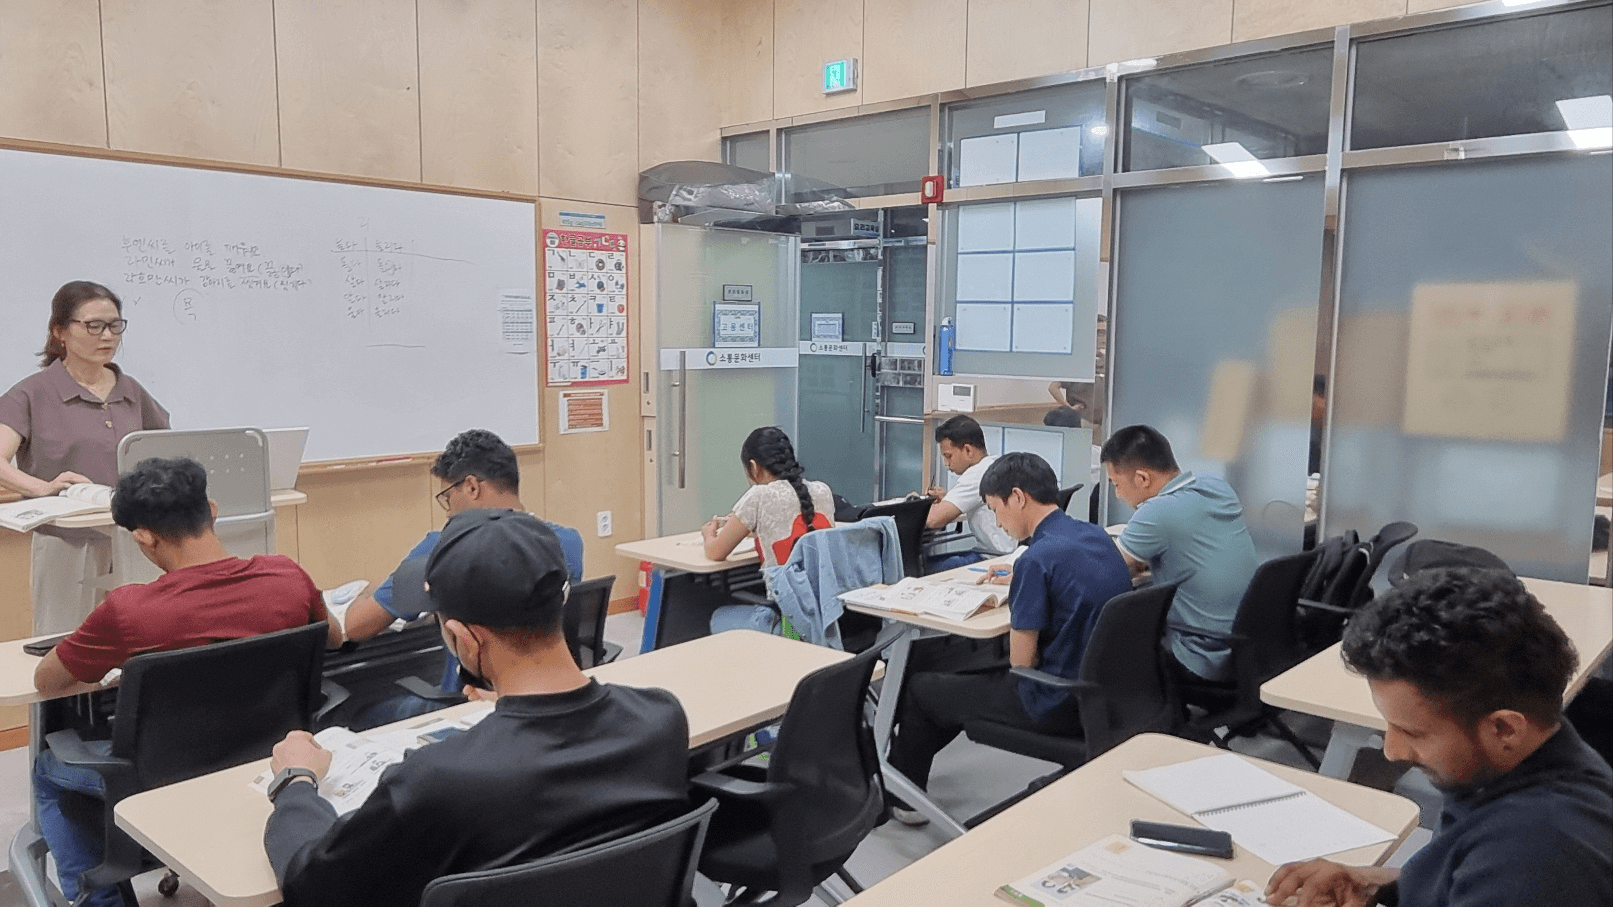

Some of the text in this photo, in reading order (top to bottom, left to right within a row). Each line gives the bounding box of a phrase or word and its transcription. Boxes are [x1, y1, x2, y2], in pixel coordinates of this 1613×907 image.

[560, 234, 592, 248] 한글공부
[184, 240, 216, 256] 아이를
[568, 295, 577, 303] ㅊ
[721, 322, 753, 332] 고용센터
[719, 352, 761, 364] 소통문화센터
